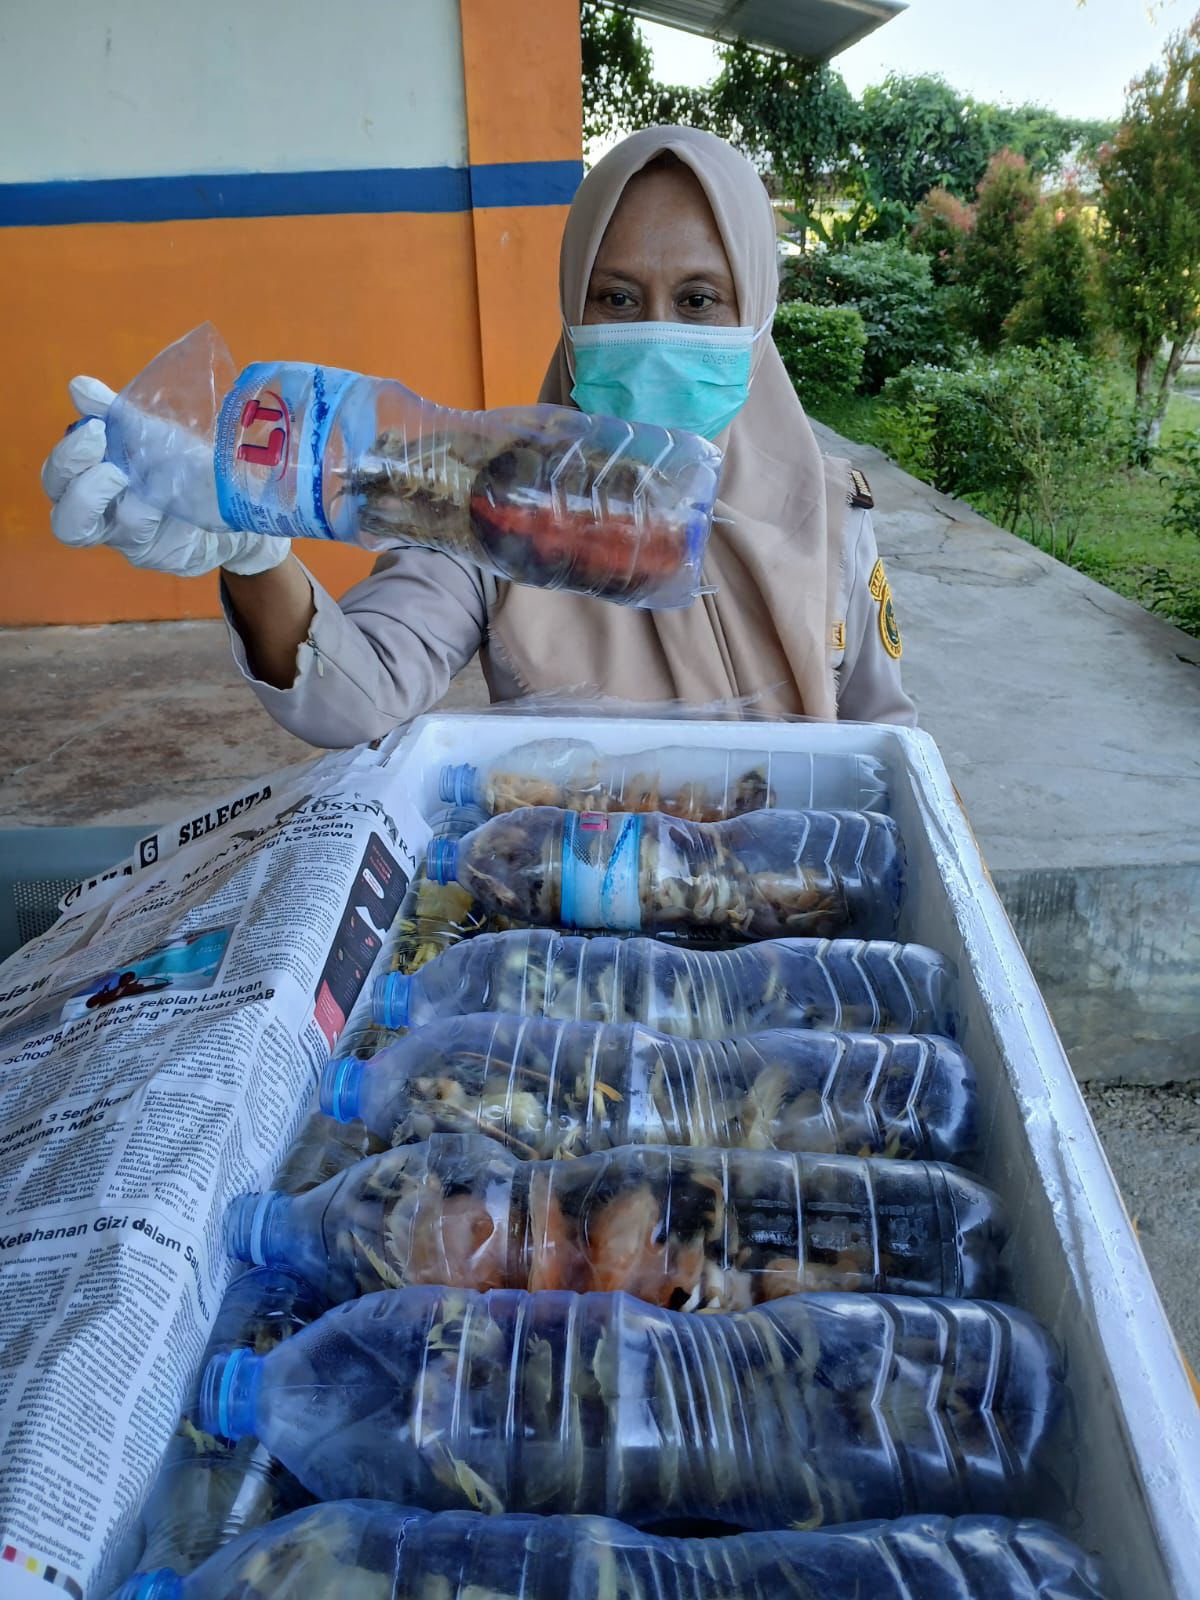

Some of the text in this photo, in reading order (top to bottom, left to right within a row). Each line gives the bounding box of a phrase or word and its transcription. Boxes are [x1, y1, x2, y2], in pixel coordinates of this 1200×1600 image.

[179, 785, 271, 847] SELECTA
[292, 822, 353, 834] Sekolah
[285, 835, 302, 843] ke
[308, 832, 352, 840] Siswa
[143, 841, 156, 862] 6
[172, 1000, 231, 1018] Perkuat
[234, 988, 275, 1005] SPAB
[22, 1031, 62, 1051] BNPB
[95, 1003, 135, 1022] Pihak
[138, 995, 198, 1010] Sekolah
[202, 980, 263, 1003] Lakukan
[46, 1113, 57, 1123] 3
[68, 1111, 105, 1131] MBG
[147, 1119, 175, 1128] Pangan
[148, 1113, 184, 1123] Menurut
[173, 1131, 201, 1139] HACCP
[123, 1151, 149, 1160] bahaya
[136, 1159, 152, 1167] fisik
[162, 1161, 190, 1170] seluruh
[140, 1167, 155, 1175] dari
[155, 1169, 189, 1178] produksi
[122, 1179, 147, 1187] Selain
[182, 1211, 195, 1222] dan
[0, 1224, 88, 1250] Ketahanan
[93, 1215, 129, 1232] Gizi
[132, 1218, 181, 1252] dalam
[27, 1410, 44, 1418] Dari
[37, 1431, 60, 1446] seperti
[51, 1425, 81, 1449] konsumsi
[83, 1447, 109, 1469] makanan
[10, 1455, 43, 1468] Program
[35, 1440, 60, 1456] hewani
[61, 1454, 86, 1473] menjadi
[30, 1469, 62, 1490] kelompok
[14, 1487, 33, 1497] terus
[84, 1511, 97, 1521] dan
[41, 1511, 65, 1528] spesifik
[67, 1525, 91, 1542] mereka
